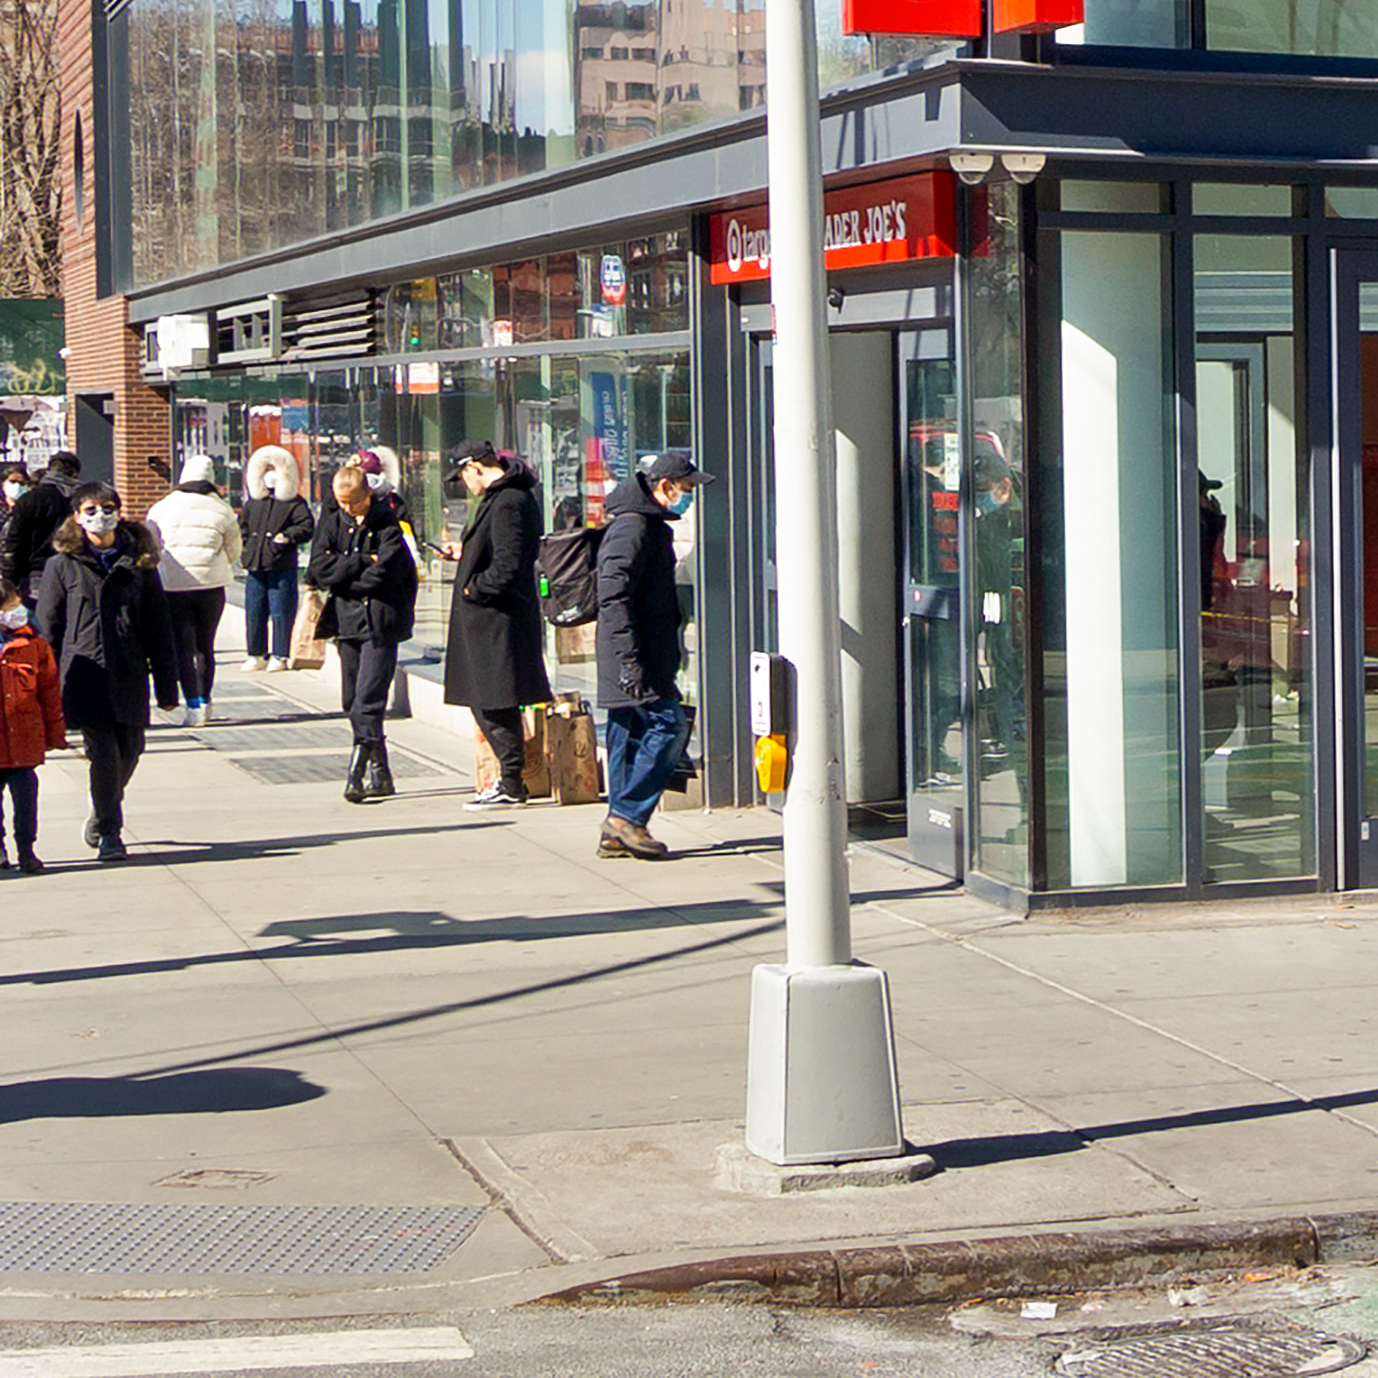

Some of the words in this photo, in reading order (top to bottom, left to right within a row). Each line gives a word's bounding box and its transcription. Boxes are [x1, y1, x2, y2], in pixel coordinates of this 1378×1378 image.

[742, 224, 771, 270] targ
[823, 210, 862, 251] ADER
[863, 200, 907, 245] JOE'S
